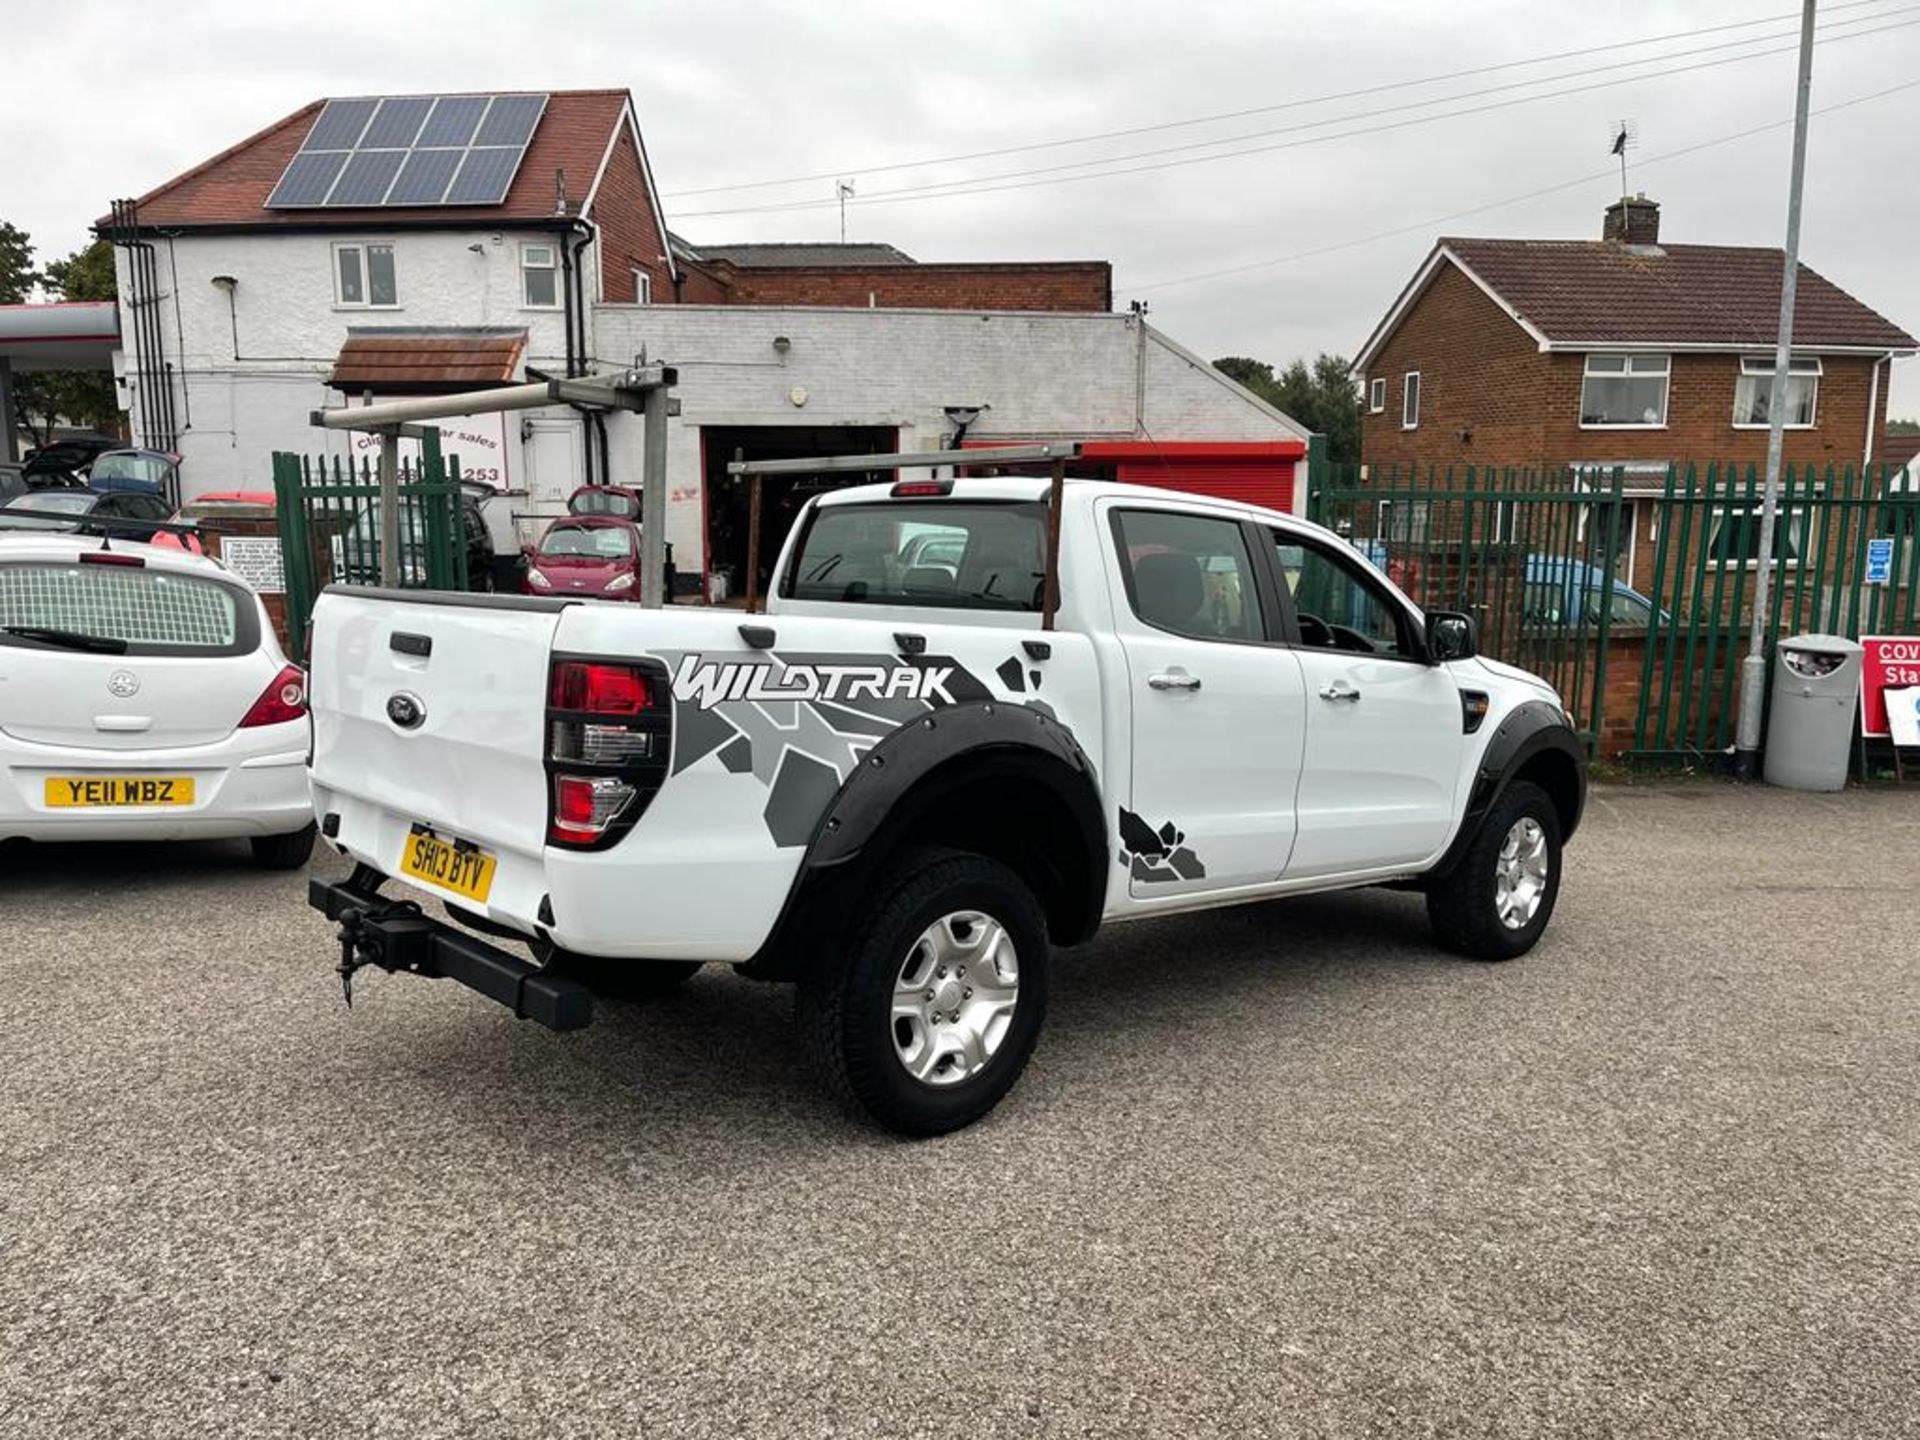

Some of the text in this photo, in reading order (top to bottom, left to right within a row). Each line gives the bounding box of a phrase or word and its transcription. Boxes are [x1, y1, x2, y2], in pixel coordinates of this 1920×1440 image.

[457, 431, 498, 449] sales
[464, 468, 499, 481] 253
[672, 653, 958, 710] WILDTRAK
[68, 780, 174, 802] YE11 WBZ
[412, 839, 485, 891] SH13 BTV
